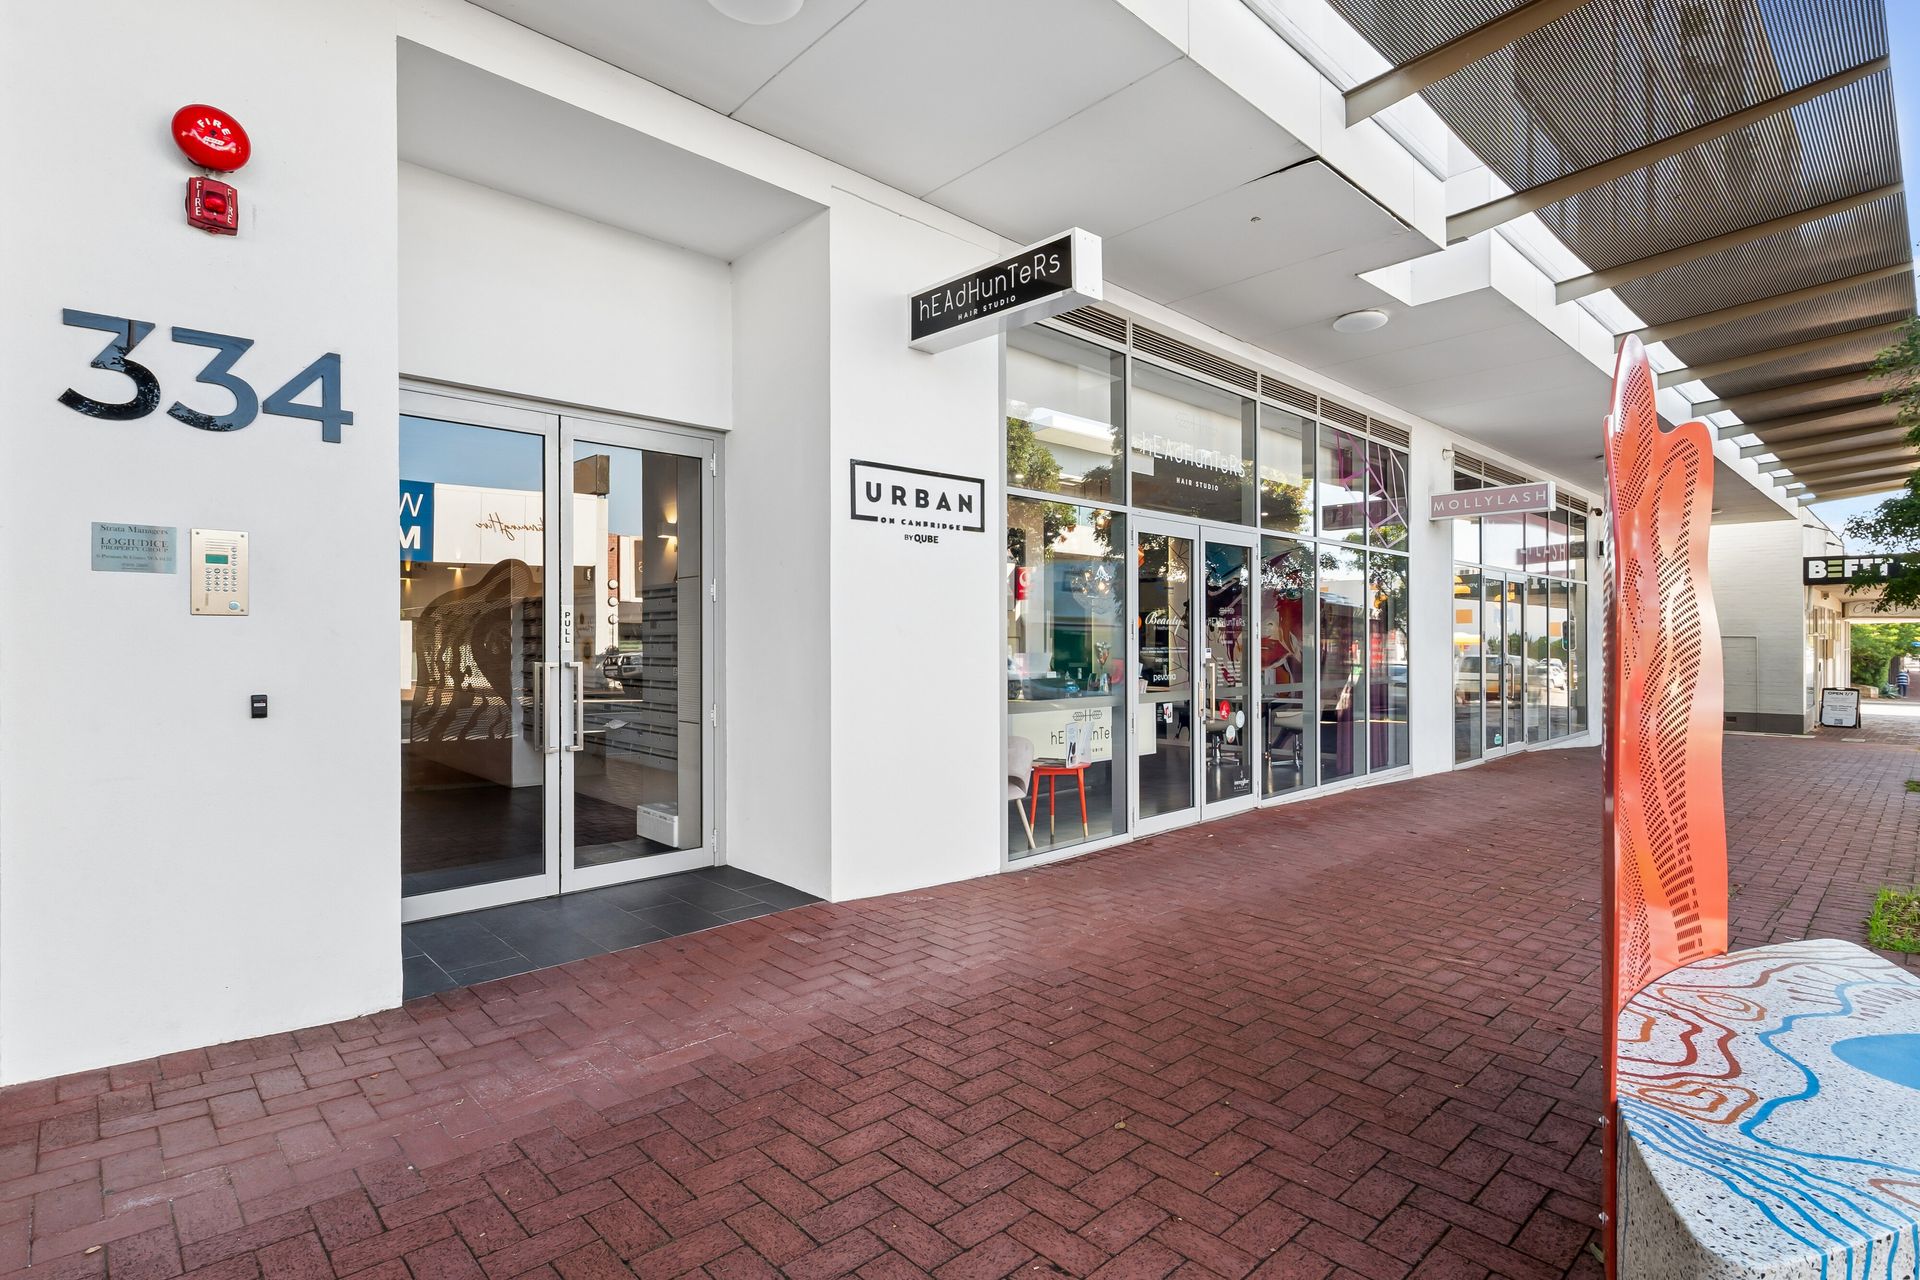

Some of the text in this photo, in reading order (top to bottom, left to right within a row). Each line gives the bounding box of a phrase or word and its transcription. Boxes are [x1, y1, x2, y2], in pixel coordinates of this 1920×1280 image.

[197, 117, 231, 136] FIRE
[957, 295, 1016, 320] HAIR STUDIO
[58, 307, 353, 443] 334
[1176, 477, 1219, 491] HAIR STUDIO
[866, 481, 972, 513] URBAN
[1433, 490, 1546, 512] MOLLYLASH
[100, 524, 168, 535] Strata Managers
[901, 519, 961, 531] CAMBRIDGE
